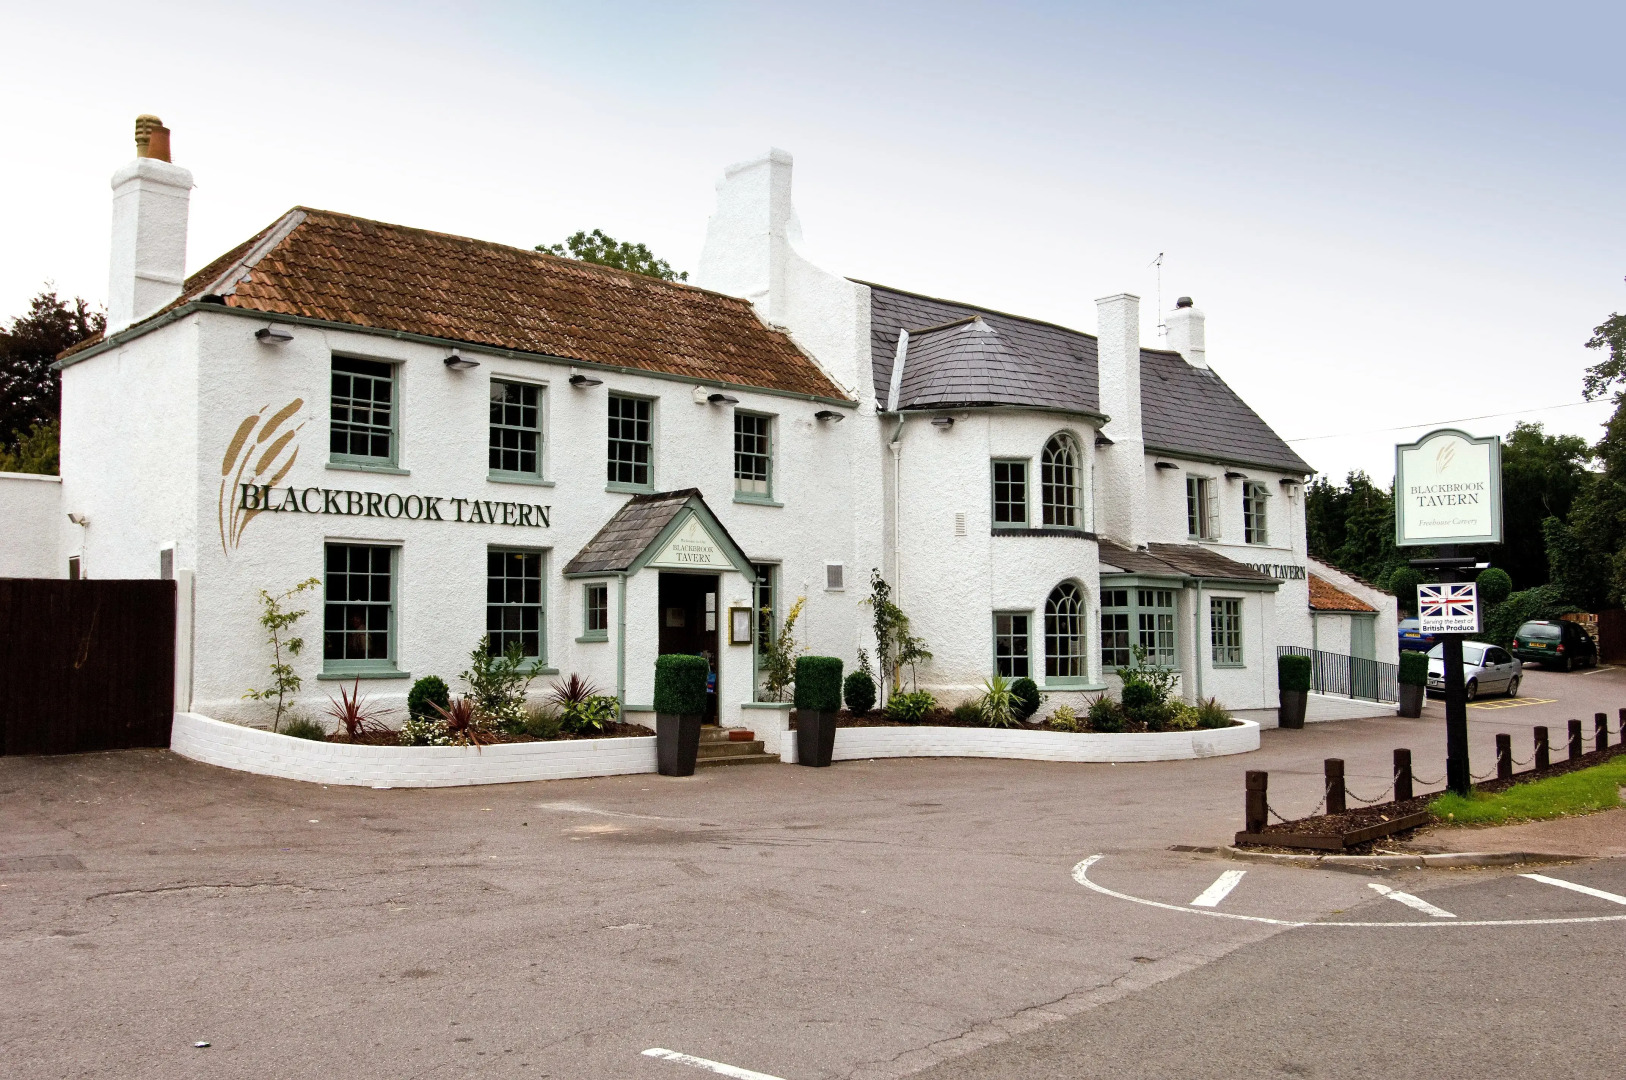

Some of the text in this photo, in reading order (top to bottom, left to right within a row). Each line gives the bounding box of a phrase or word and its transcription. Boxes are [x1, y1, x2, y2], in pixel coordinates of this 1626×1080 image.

[1411, 482, 1484, 494] BLACKBROOK
[239, 483, 552, 528] BLACKBROOK TAVERN
[1416, 493, 1479, 507] TAVERN
[673, 544, 713, 552] BLACKBROOK
[676, 553, 710, 562] TAVERN
[1273, 565, 1306, 580] TAVERN
